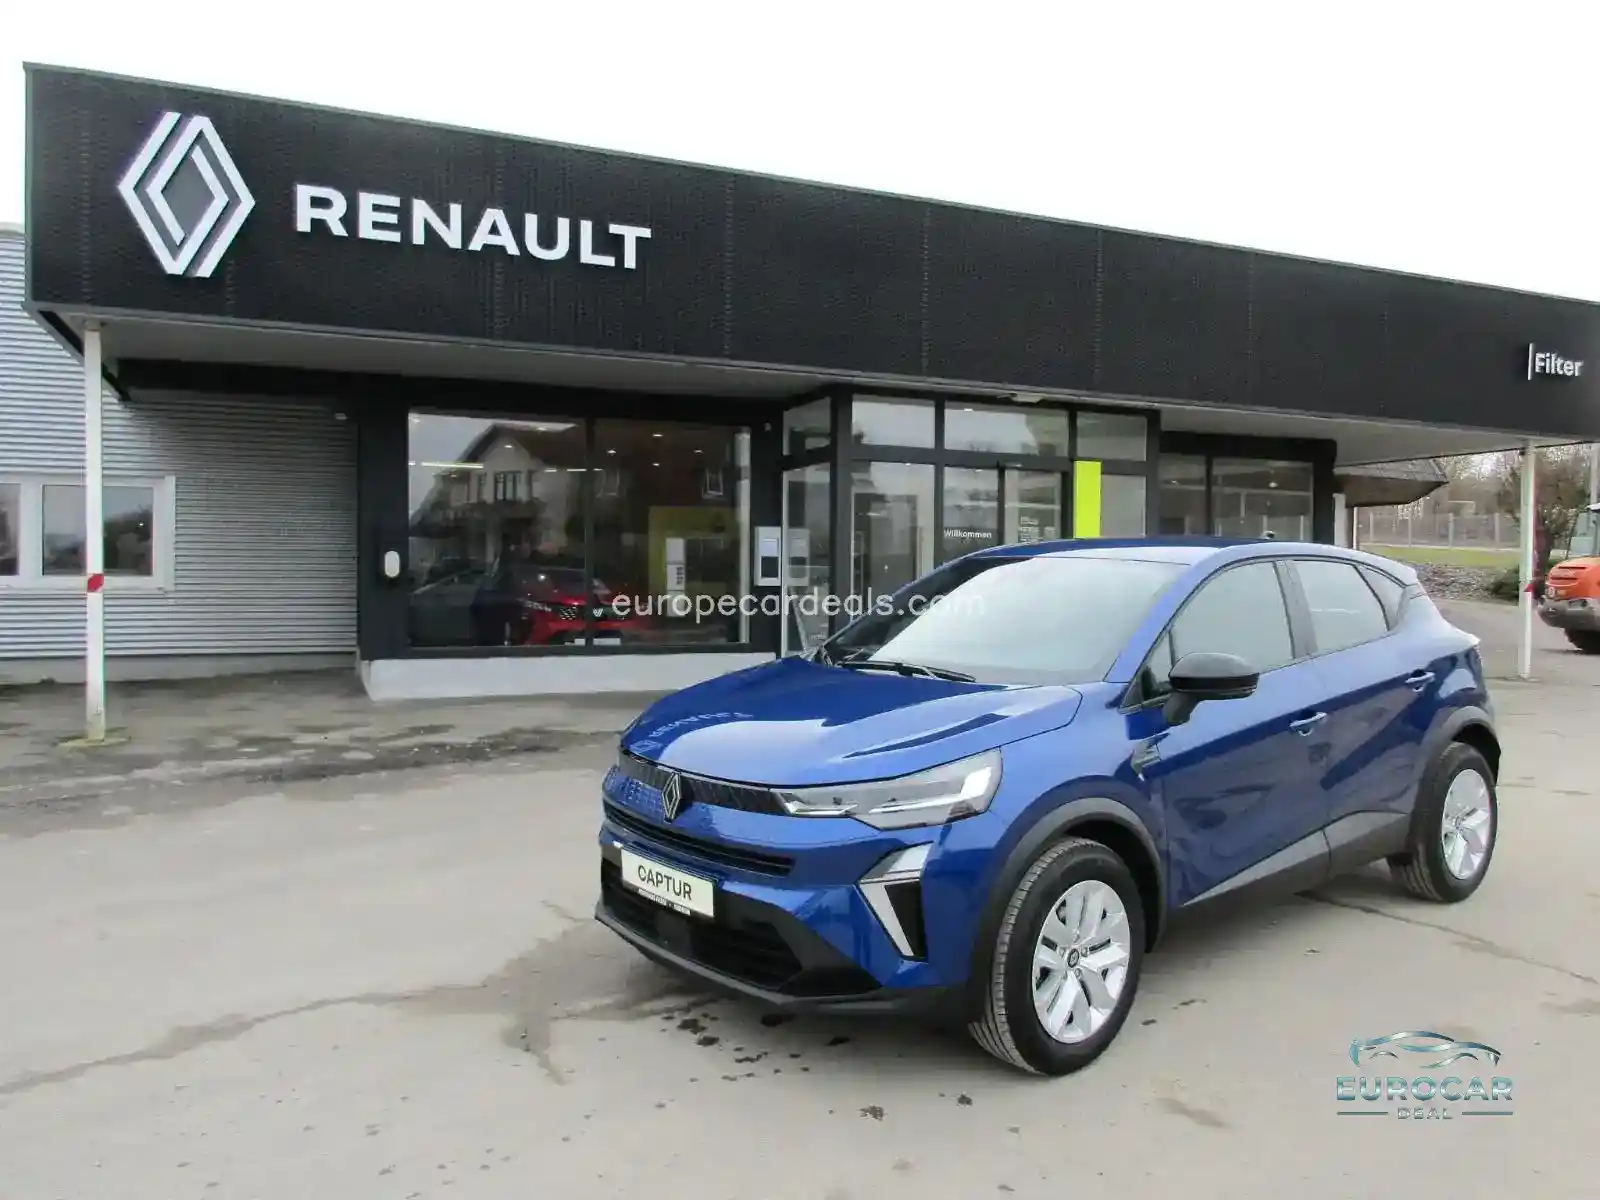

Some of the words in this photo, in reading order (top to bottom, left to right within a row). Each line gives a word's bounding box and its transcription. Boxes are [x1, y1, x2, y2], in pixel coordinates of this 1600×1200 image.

[295, 184, 652, 270] RENAULT
[1535, 352, 1584, 377] Filter
[943, 528, 992, 539] Willkommen
[637, 865, 692, 901] CAPTUR
